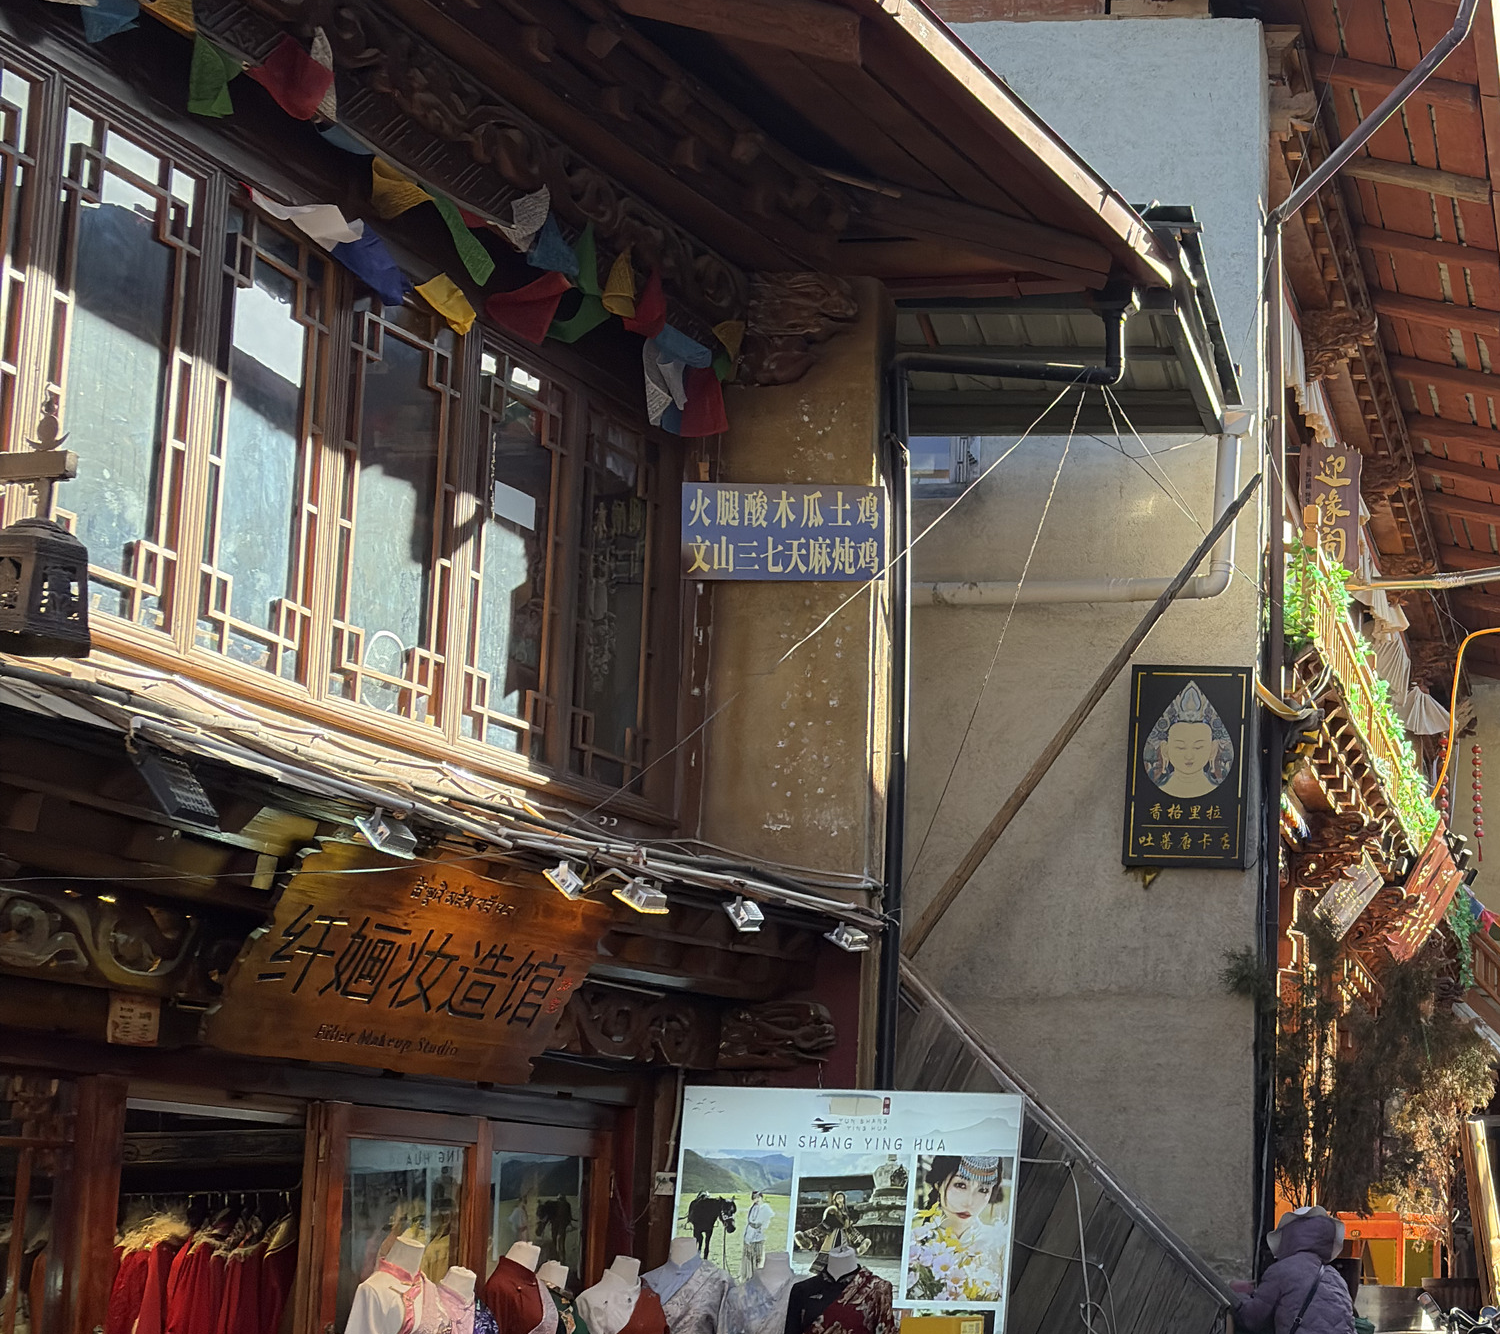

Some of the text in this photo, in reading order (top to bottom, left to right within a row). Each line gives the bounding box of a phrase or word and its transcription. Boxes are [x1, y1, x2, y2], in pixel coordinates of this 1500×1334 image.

[688, 488, 879, 529] 火腿酸木瓜土鸡
[1314, 454, 1352, 563] 迎缘阁
[687, 535, 880, 575] 文山三七天麻炖鸡
[1149, 803, 1223, 821] 香格里拉
[1138, 832, 1231, 851] 吐蕃唐卡店
[355, 1028, 411, 1053] Makeup
[417, 1037, 458, 1056] Studio
[755, 1133, 947, 1152] YUN SHANG YING HUA
